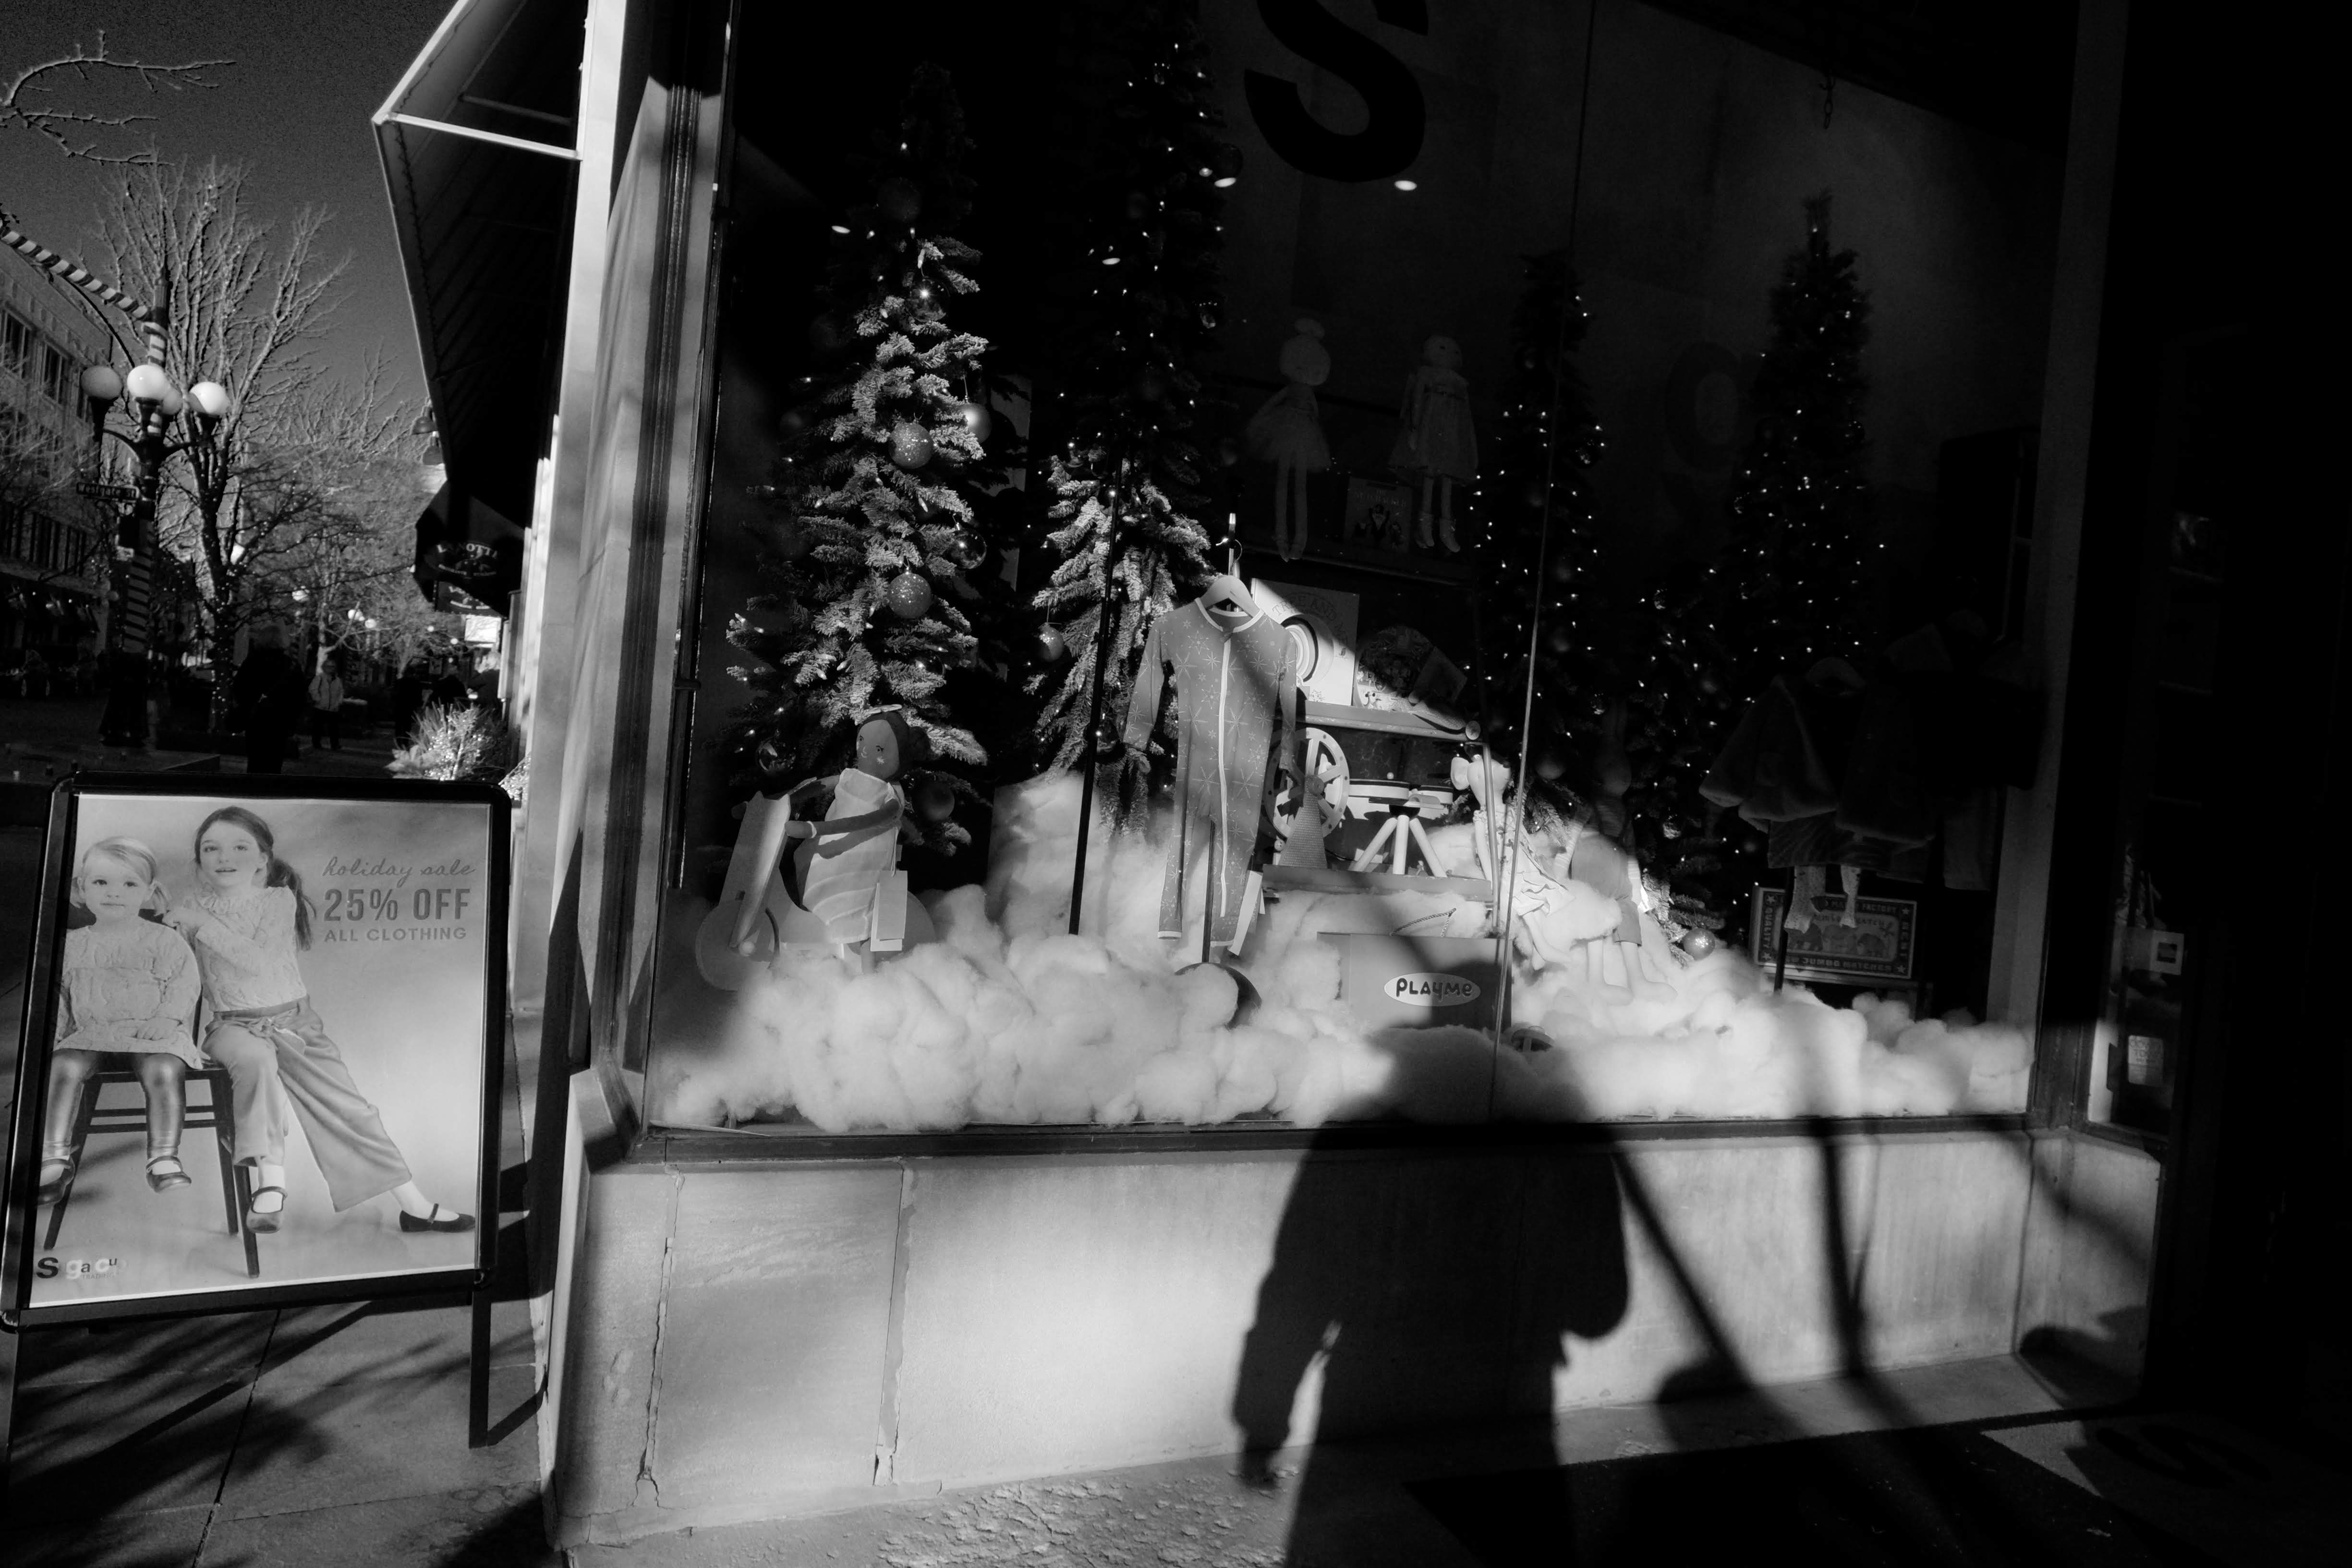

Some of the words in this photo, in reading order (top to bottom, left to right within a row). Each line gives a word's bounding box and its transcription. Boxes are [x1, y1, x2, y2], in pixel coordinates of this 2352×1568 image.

[1244, 0, 1429, 182] S
[322, 856, 412, 888] holiday
[420, 859, 475, 876] sale
[324, 889, 398, 921] 25%
[413, 888, 470, 920] OFF
[324, 929, 358, 942] ALL
[367, 927, 466, 941] CLOTHING
